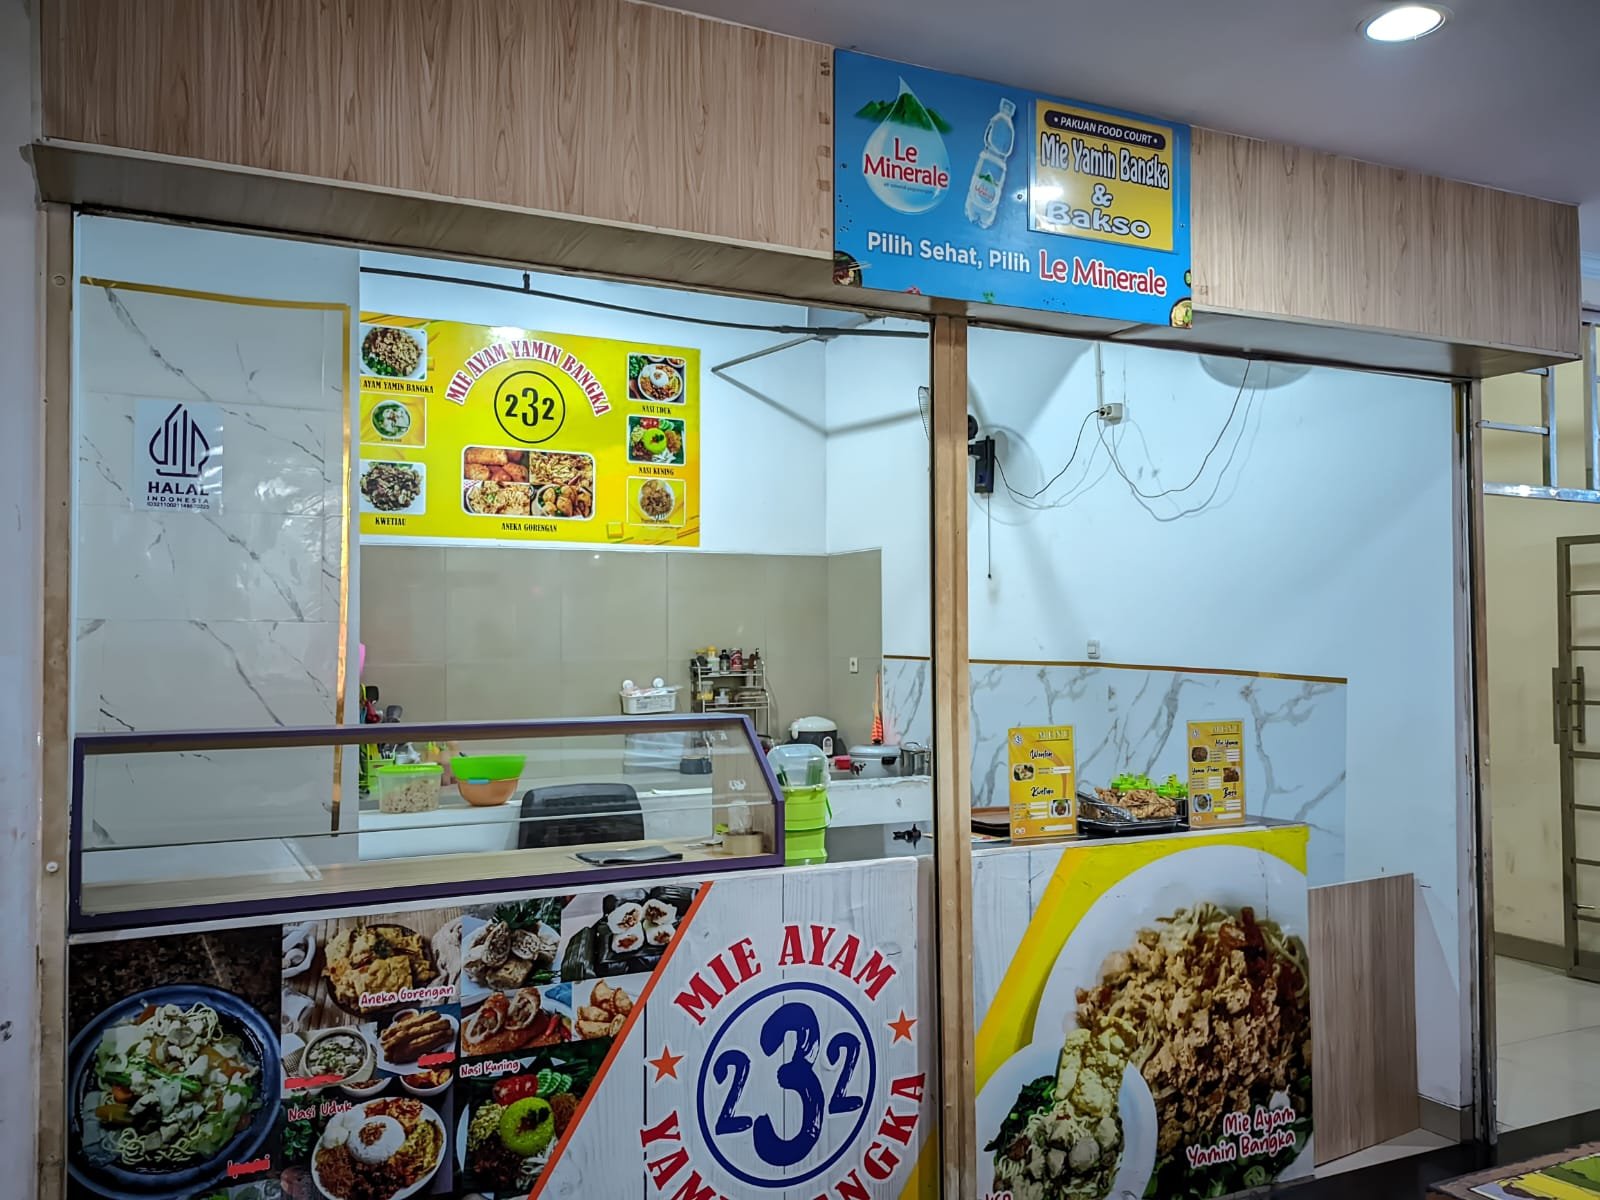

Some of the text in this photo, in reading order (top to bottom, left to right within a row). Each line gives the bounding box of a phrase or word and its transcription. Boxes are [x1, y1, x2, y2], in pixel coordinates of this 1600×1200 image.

[1060, 116, 1152, 144] PAKUAN FOOD COURT
[894, 138, 918, 163] Le
[1040, 132, 1169, 190] Mie Yamin Bangka
[863, 153, 949, 188] Minerale
[1091, 183, 1113, 207] &
[1045, 200, 1151, 239] Bakso
[867, 231, 1167, 297] Pilih Sehat, Pilih Le Minerale
[363, 379, 434, 393] AYAM YAMIN BANGKA
[446, 340, 610, 415] MIE AYAM YAMIN BANGKA
[505, 387, 555, 427] 232
[148, 481, 209, 495] HALAL
[375, 517, 407, 526] KWETIAU
[501, 522, 522, 531] ANEKA
[674, 924, 897, 1026] MIE AYAM
[360, 985, 455, 1008] Aneka Gorengan
[459, 1059, 521, 1077] Nasi Kuning
[713, 1002, 864, 1166] 232
[288, 1100, 353, 1122] Nasi Uduk
[1223, 1107, 1296, 1136] Mie Ayam
[1187, 1131, 1296, 1168] Yamin Bangka
